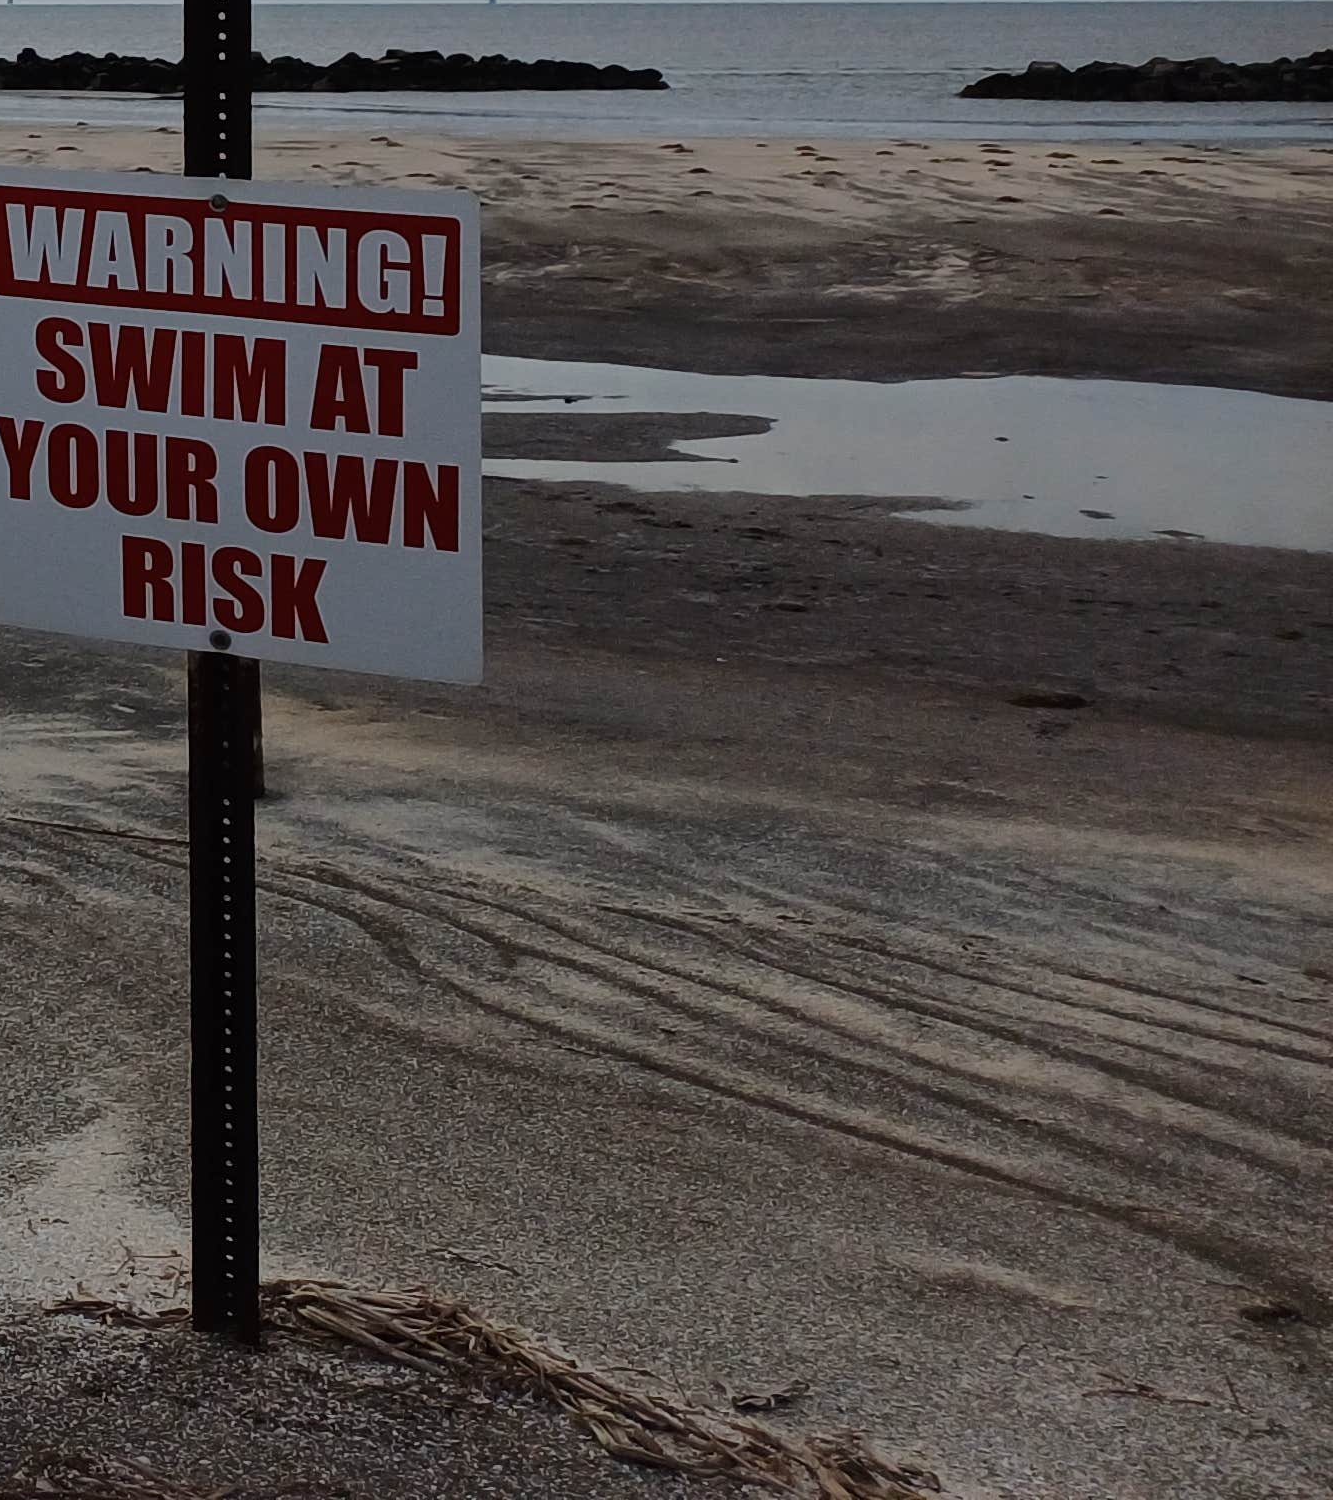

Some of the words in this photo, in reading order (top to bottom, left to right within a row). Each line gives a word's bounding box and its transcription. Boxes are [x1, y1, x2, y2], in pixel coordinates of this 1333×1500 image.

[5, 203, 447, 317] WARNING!
[35, 317, 286, 426] SWIM
[310, 344, 418, 438] AT
[244, 445, 460, 552] OWN
[122, 535, 329, 644] RISK
